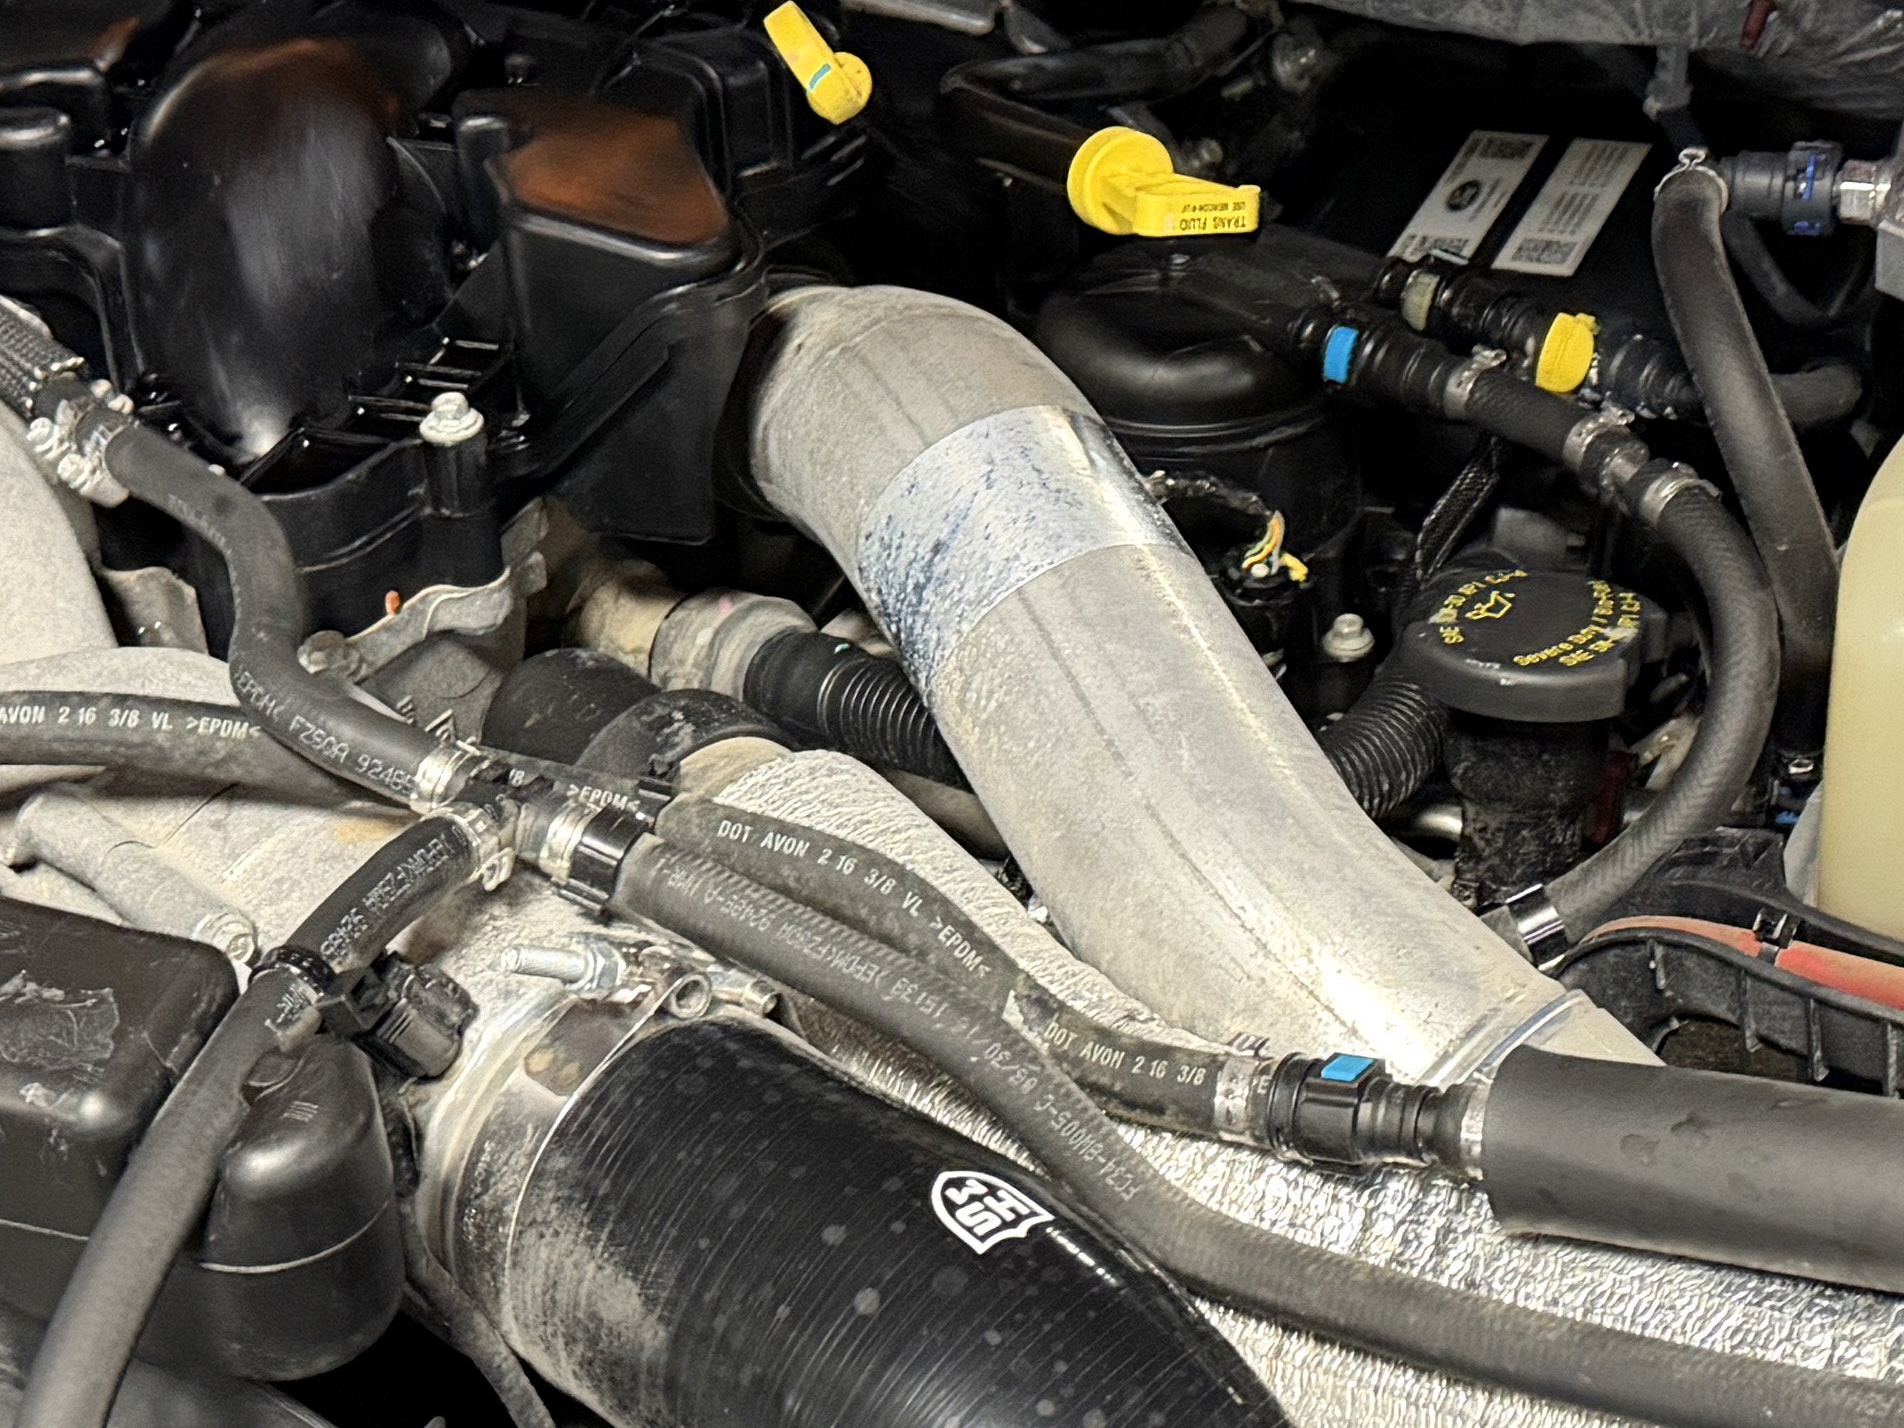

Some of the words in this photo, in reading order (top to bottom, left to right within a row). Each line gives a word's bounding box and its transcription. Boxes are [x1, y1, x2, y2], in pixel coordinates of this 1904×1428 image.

[1212, 215, 1247, 229] TRANS
[57, 706, 70, 725] 2
[77, 706, 97, 726] 16
[108, 708, 140, 729] 3/8
[151, 711, 174, 731] VL
[185, 714, 262, 741] >EPDM<
[716, 819, 753, 844] DOT
[759, 830, 812, 858] AVON
[816, 847, 831, 865] 2
[836, 853, 856, 875] 16
[862, 867, 897, 896] 3/8
[900, 891, 924, 918] VL
[928, 915, 994, 979] >EPDM<
[1044, 1020, 1075, 1049] DOT
[1079, 1041, 1127, 1071] AVON
[1130, 1055, 1146, 1075] 2
[1148, 1058, 1168, 1081] 16
[1176, 1062, 1207, 1087] 3/8
